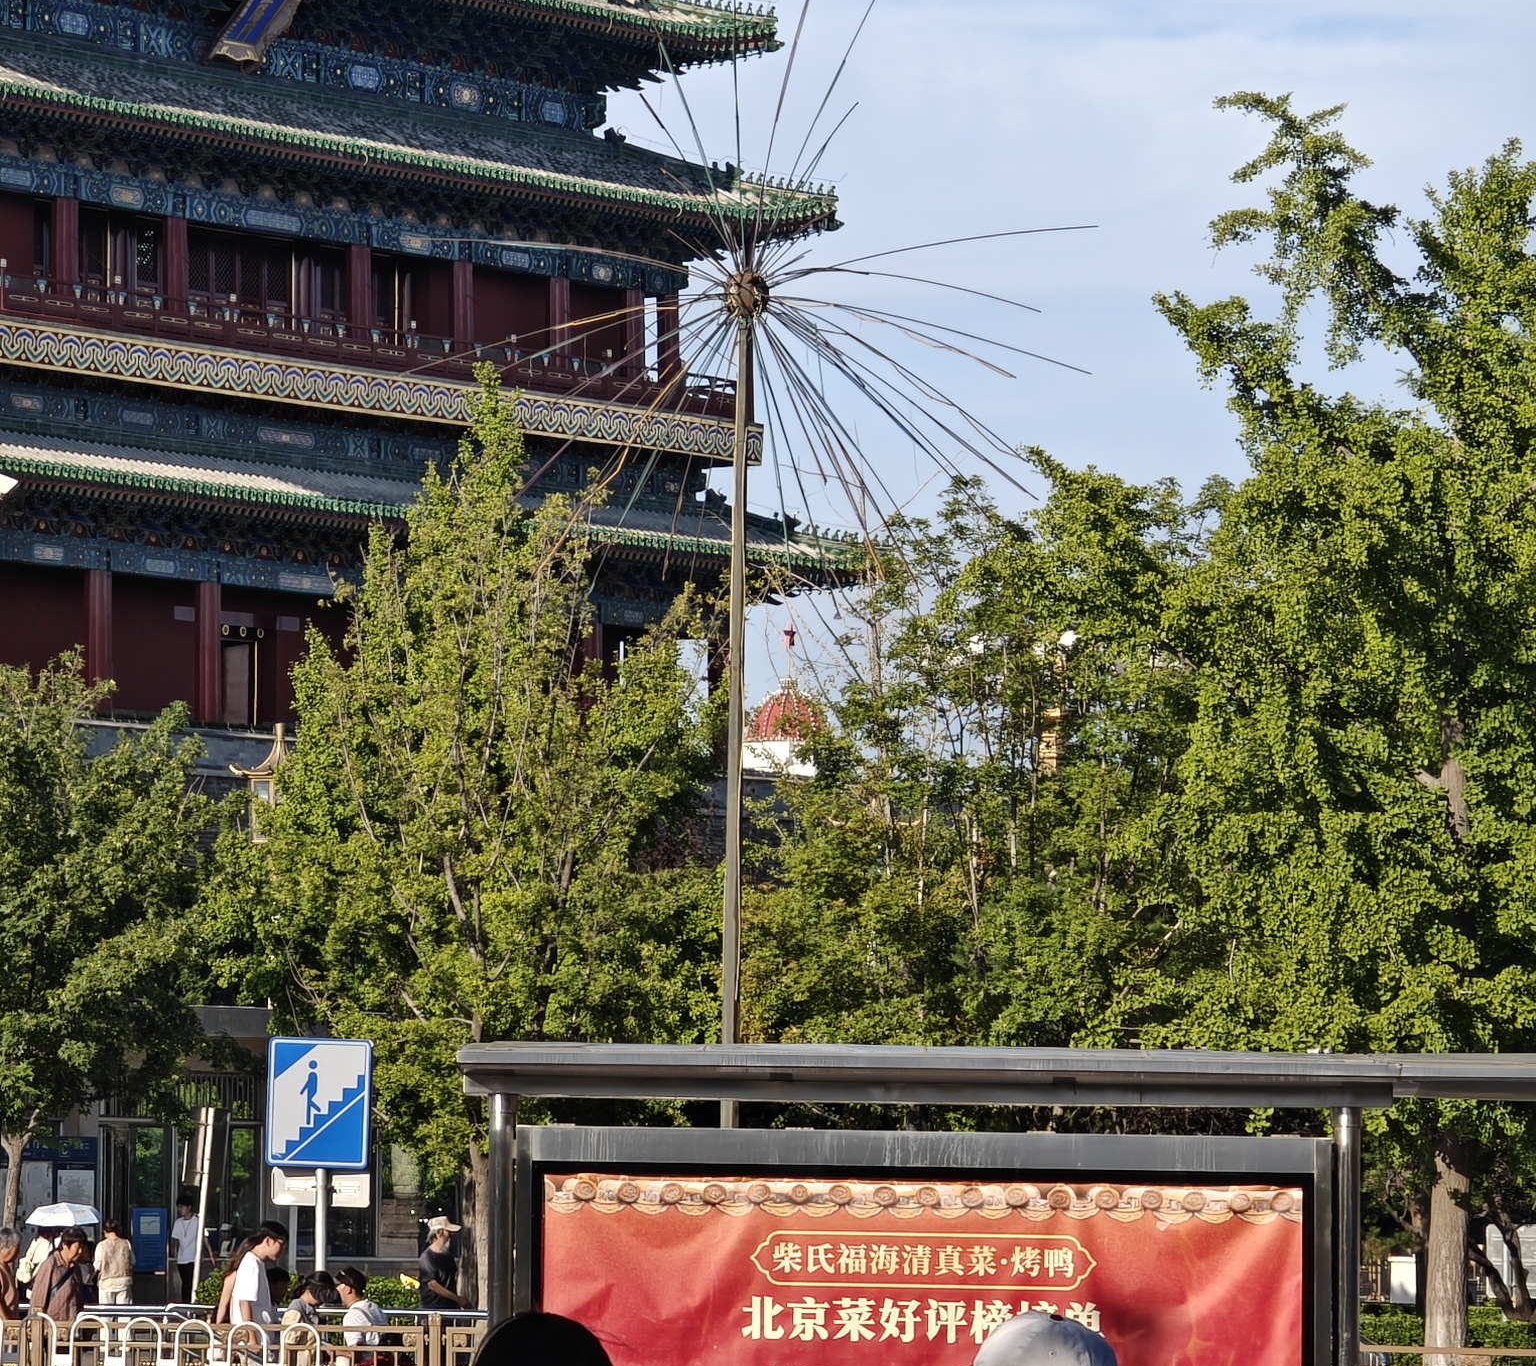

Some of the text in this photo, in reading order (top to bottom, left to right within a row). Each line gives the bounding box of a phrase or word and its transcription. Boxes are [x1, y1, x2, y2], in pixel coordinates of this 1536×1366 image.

[772, 1242, 1076, 1279] 柴氏福海清真菜·烤鸭
